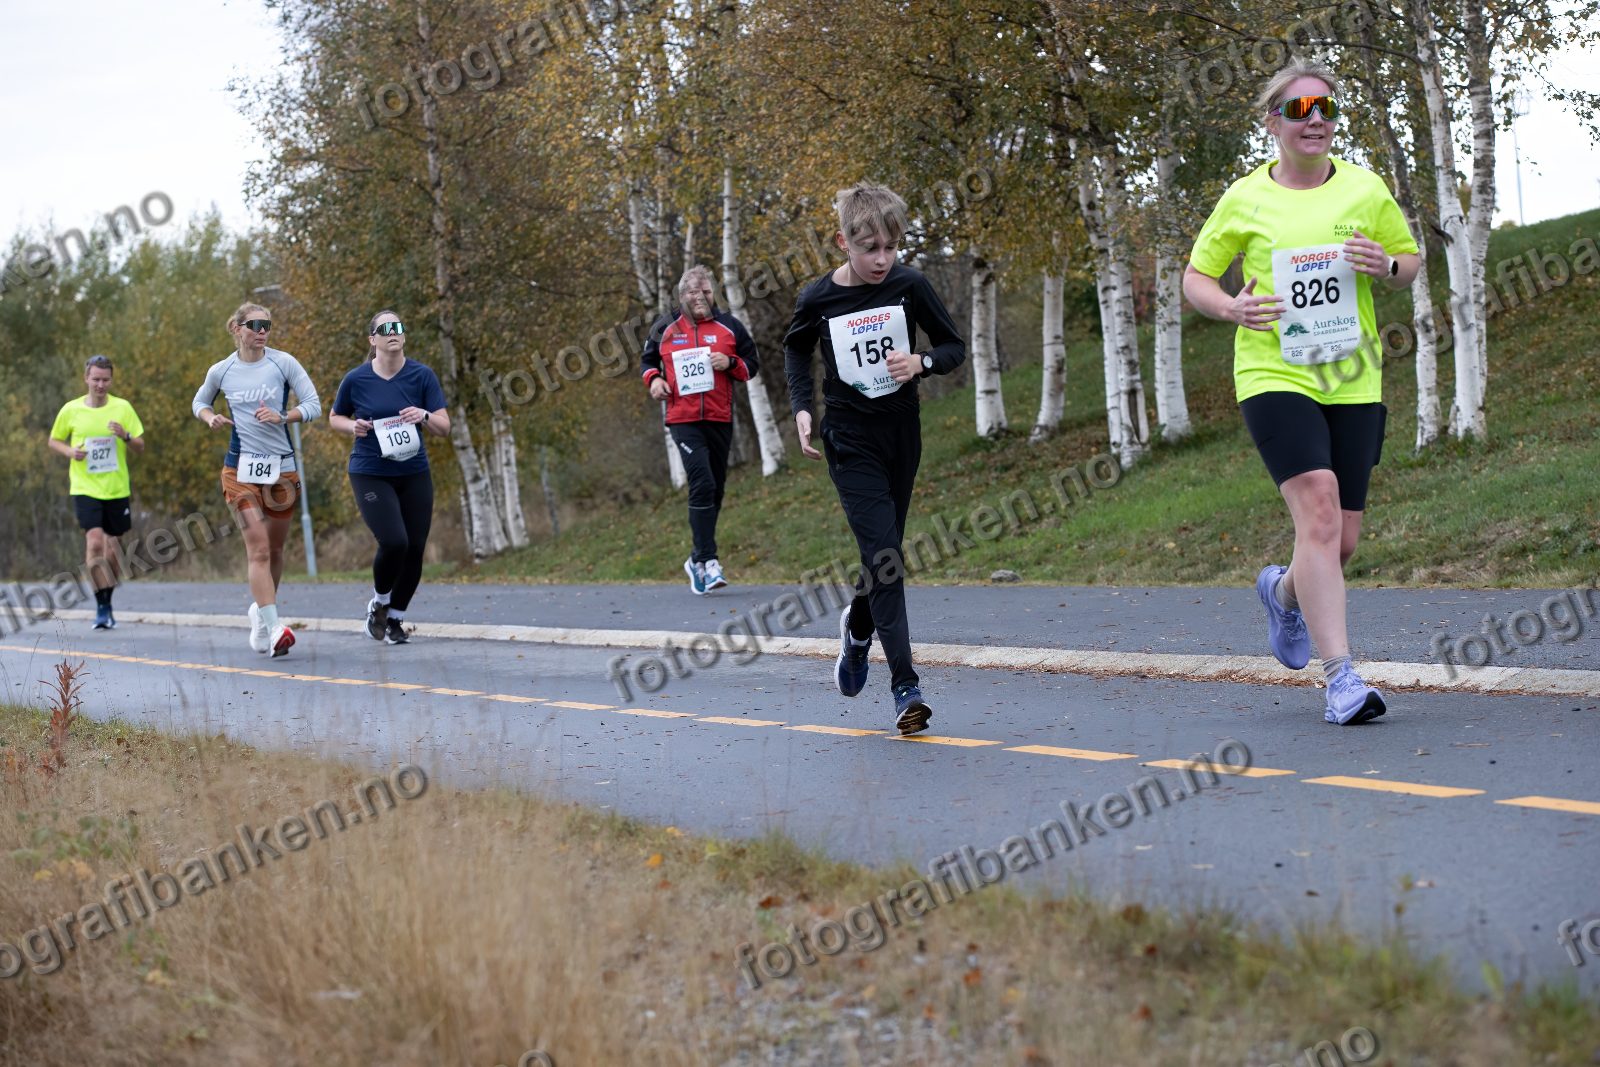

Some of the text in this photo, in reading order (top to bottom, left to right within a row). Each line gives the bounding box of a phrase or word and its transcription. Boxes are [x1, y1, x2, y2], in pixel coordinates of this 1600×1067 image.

[1291, 251, 1338, 265] NORGES
[1295, 260, 1332, 273] LØPET
[1291, 276, 1340, 309] 826
[846, 312, 891, 328] NORGES
[1313, 315, 1356, 330] Aurskog
[852, 322, 885, 335] LØPET
[850, 336, 895, 368] 158
[1331, 344, 1343, 352] 826
[682, 362, 705, 377] 326
[387, 430, 411, 447] 109
[92, 448, 111, 460] 827
[248, 462, 272, 478] 184
